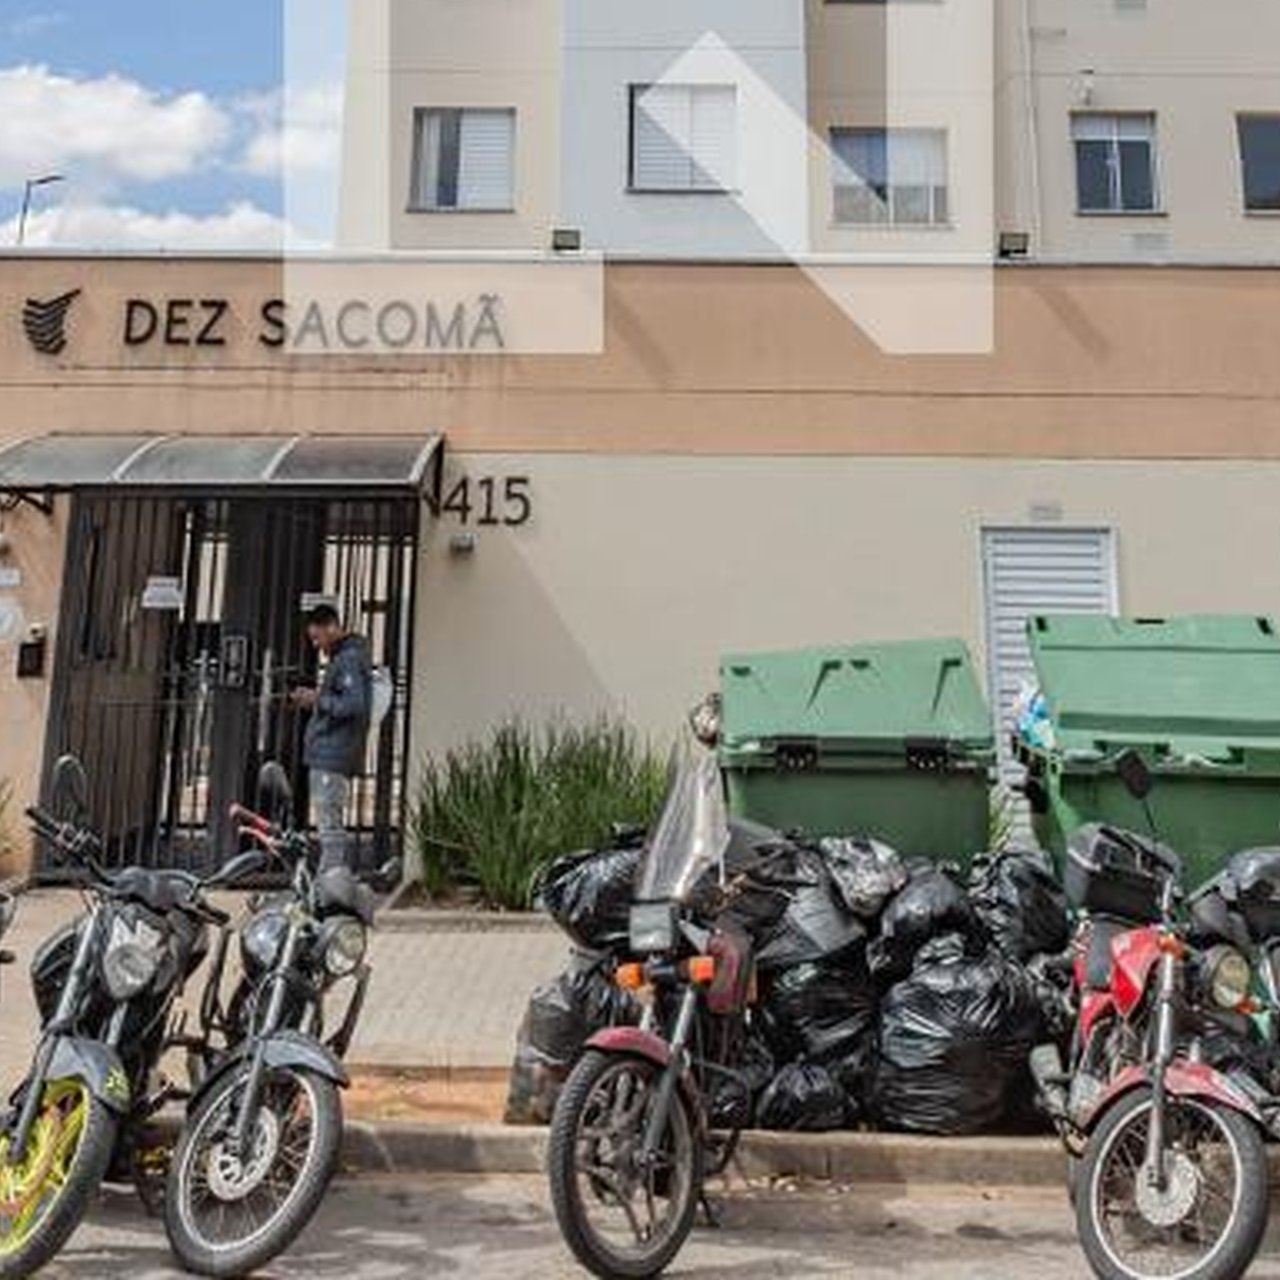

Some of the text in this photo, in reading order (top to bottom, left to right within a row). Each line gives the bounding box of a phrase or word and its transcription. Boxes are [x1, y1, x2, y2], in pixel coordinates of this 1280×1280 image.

[124, 293, 505, 349] DEZ SACOMÃ
[442, 476, 532, 527] 415
